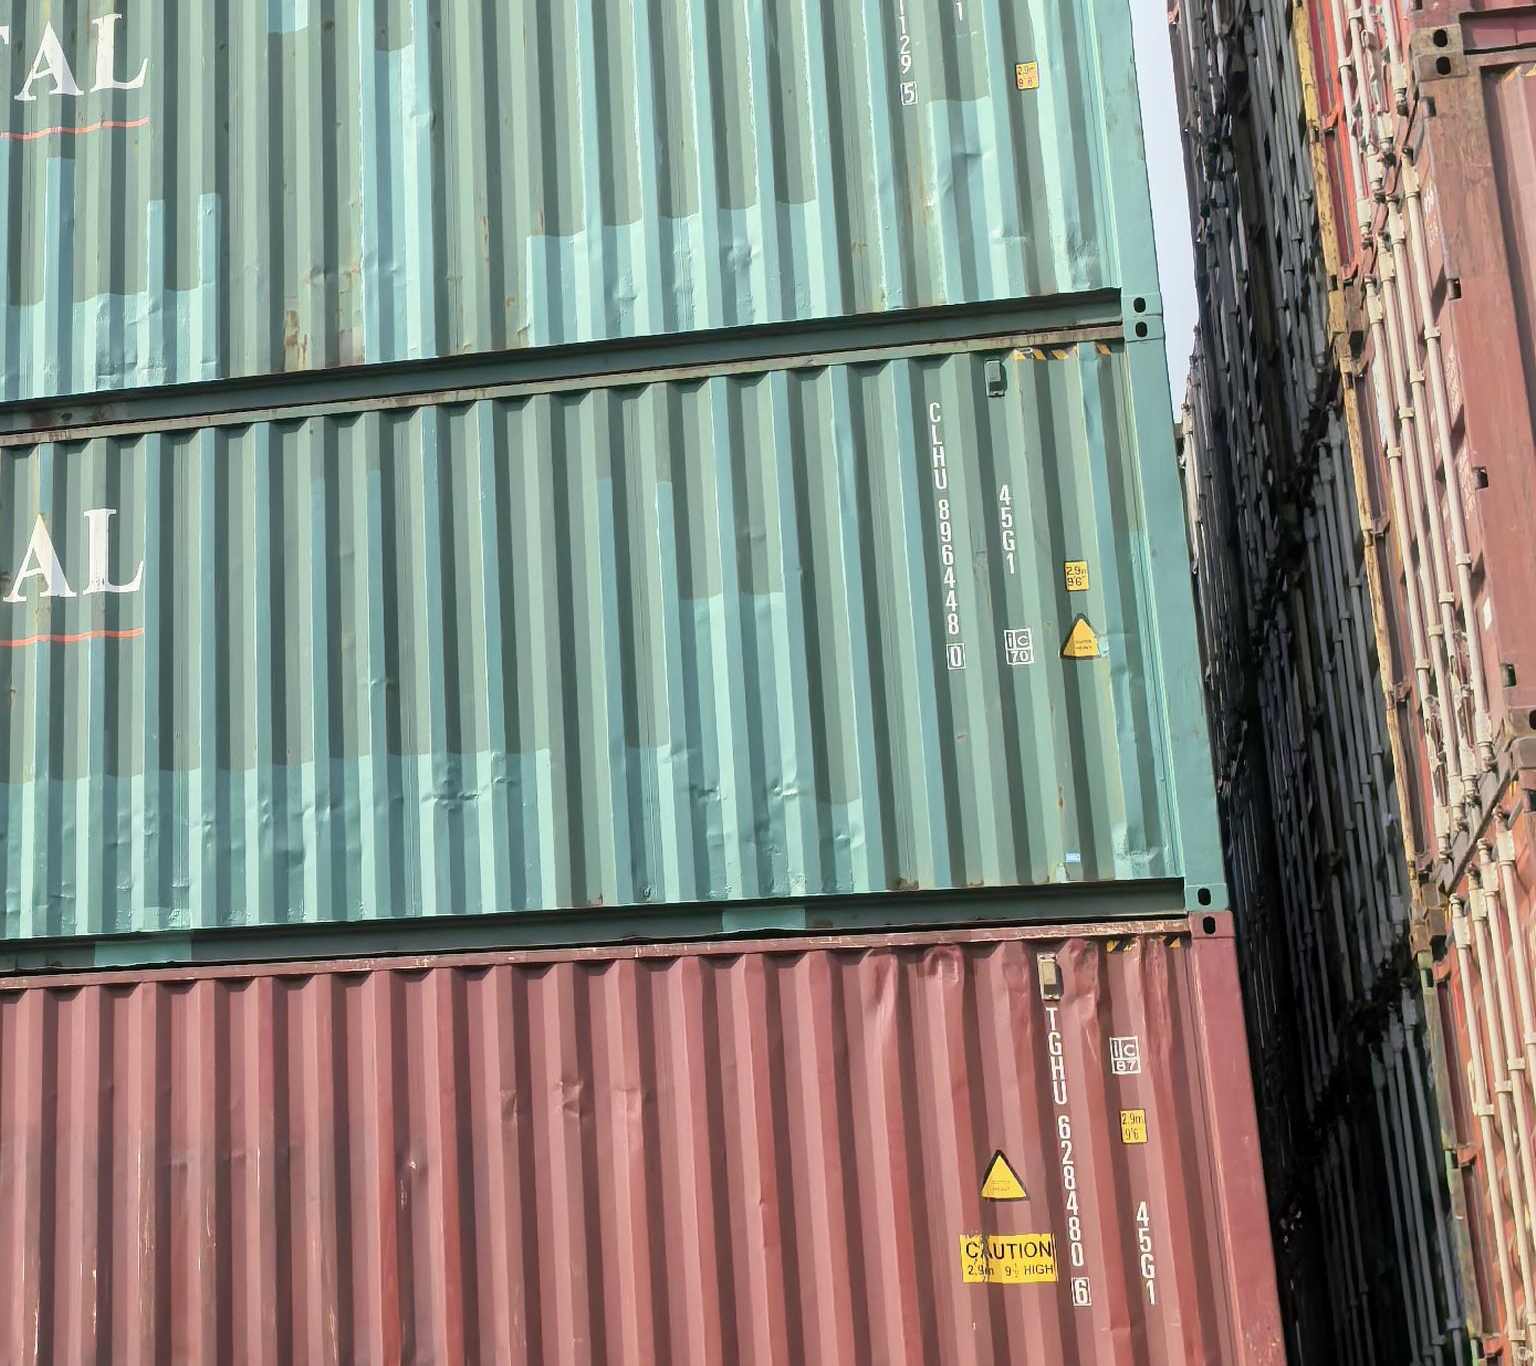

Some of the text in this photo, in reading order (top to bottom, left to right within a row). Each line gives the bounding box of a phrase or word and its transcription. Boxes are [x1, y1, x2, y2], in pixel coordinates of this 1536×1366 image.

[929, 402, 948, 490] CLHU
[938, 499, 959, 635] 896448
[999, 484, 1016, 574] 45G1
[1010, 650, 1030, 664] 70
[1045, 1006, 1088, 1304] TGHU 628480 6
[965, 1241, 1053, 1260] CAUTION
[1024, 1264, 1054, 1276] HIGH
[1136, 1201, 1155, 1305] 45G1
